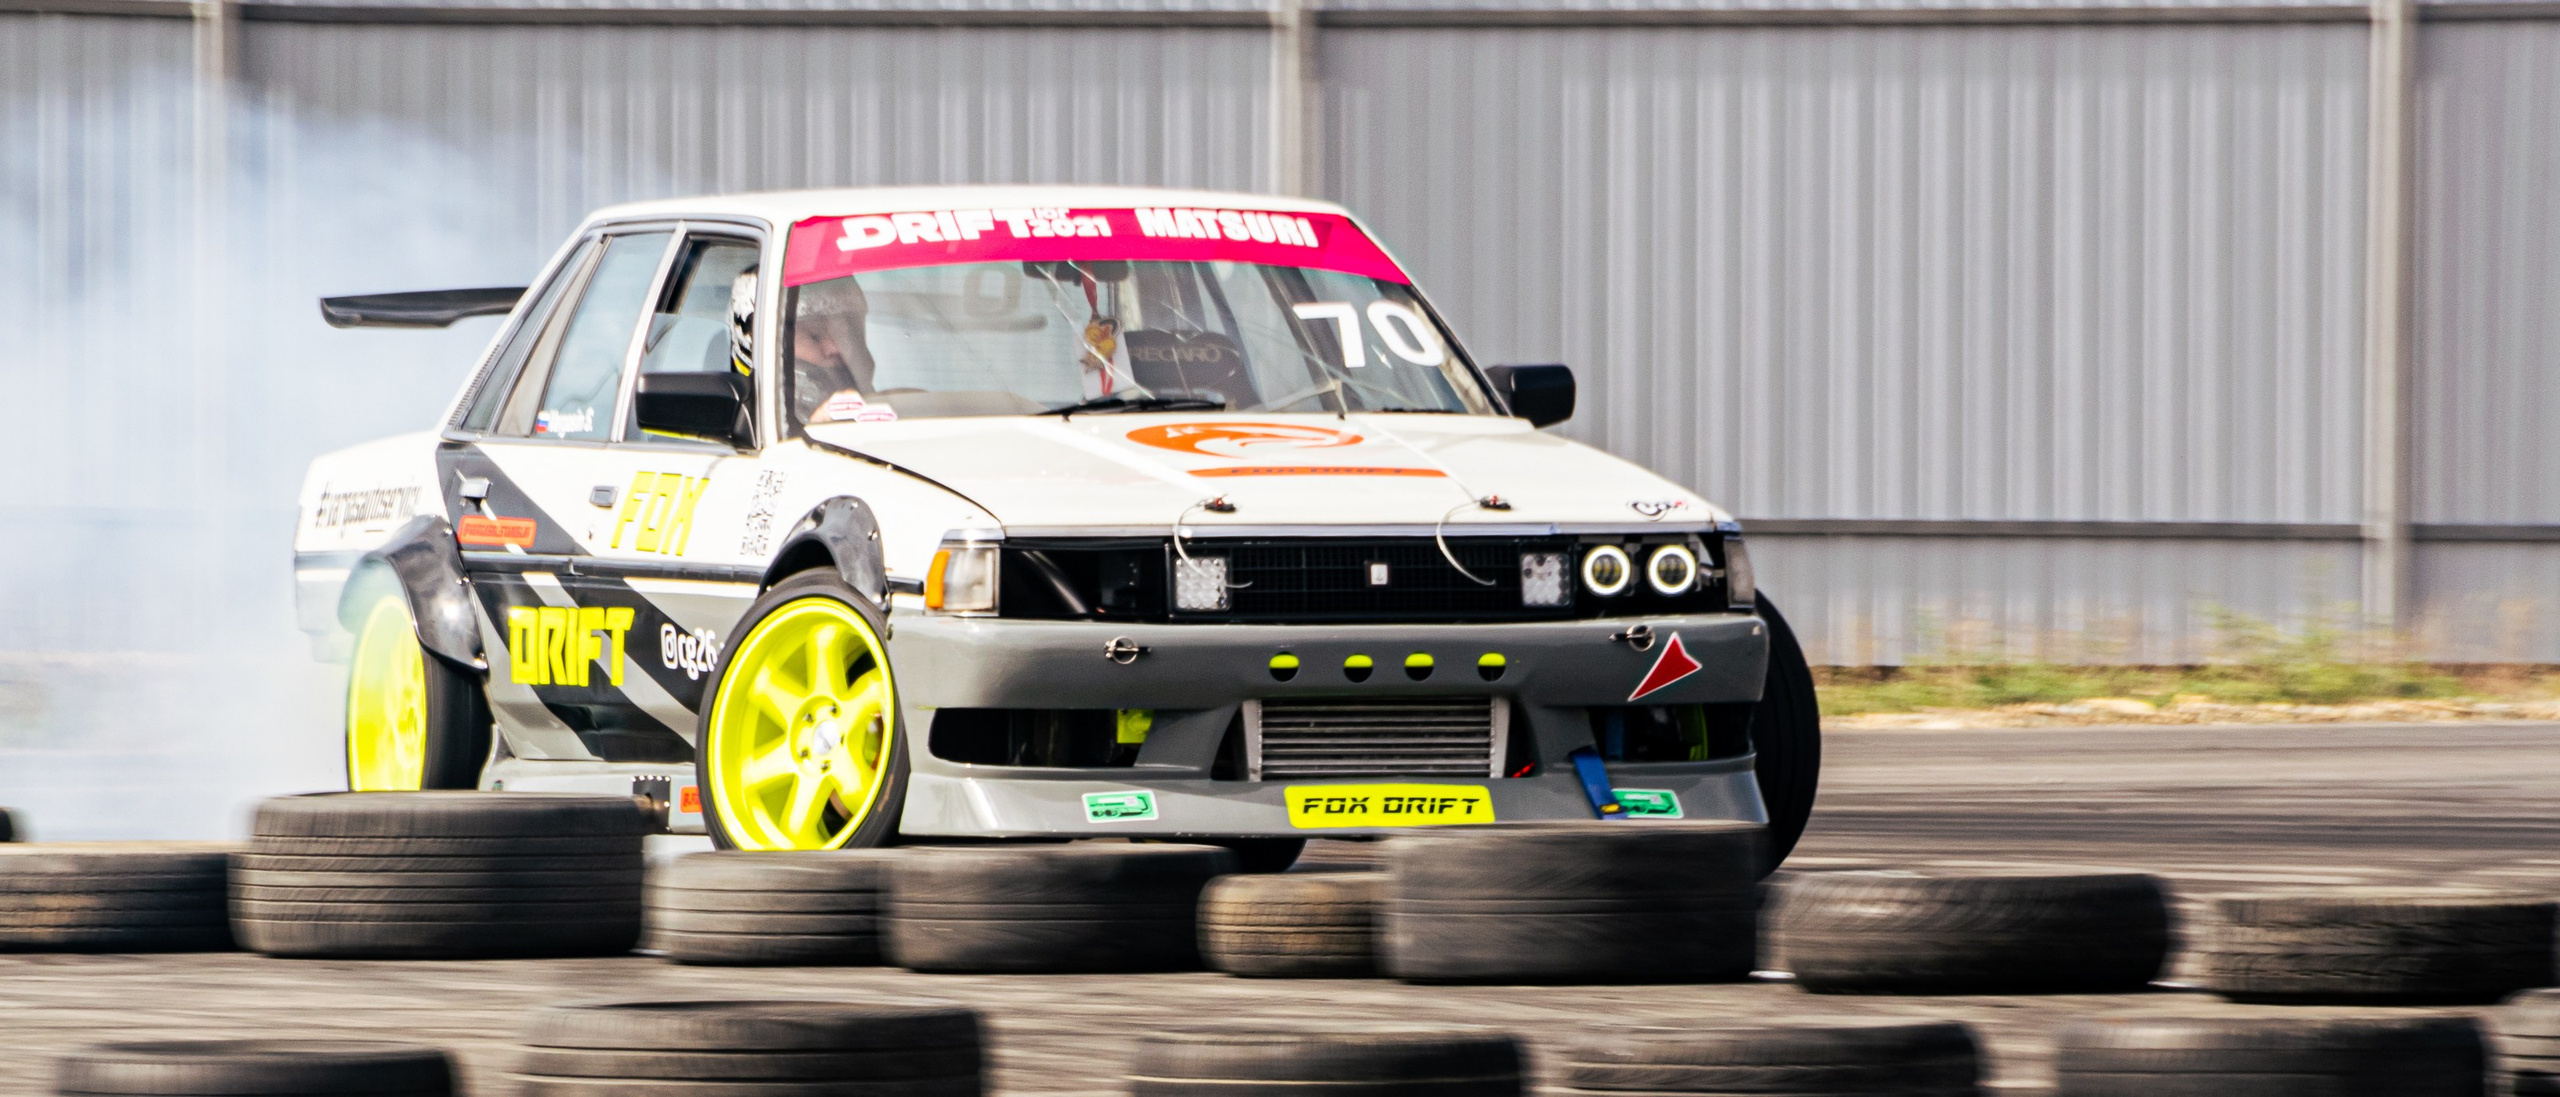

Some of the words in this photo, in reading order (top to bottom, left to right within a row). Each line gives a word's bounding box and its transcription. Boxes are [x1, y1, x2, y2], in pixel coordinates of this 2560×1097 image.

[836, 208, 1032, 251] DRIFT
[1027, 215, 1113, 237] 2021
[1134, 208, 1319, 248] MATSURI
[1292, 301, 1444, 368] 70
[611, 471, 711, 557] FOX
[508, 605, 636, 687] DRIFT
[1303, 796, 1370, 814] FOX
[1382, 796, 1480, 815] DRIFT
